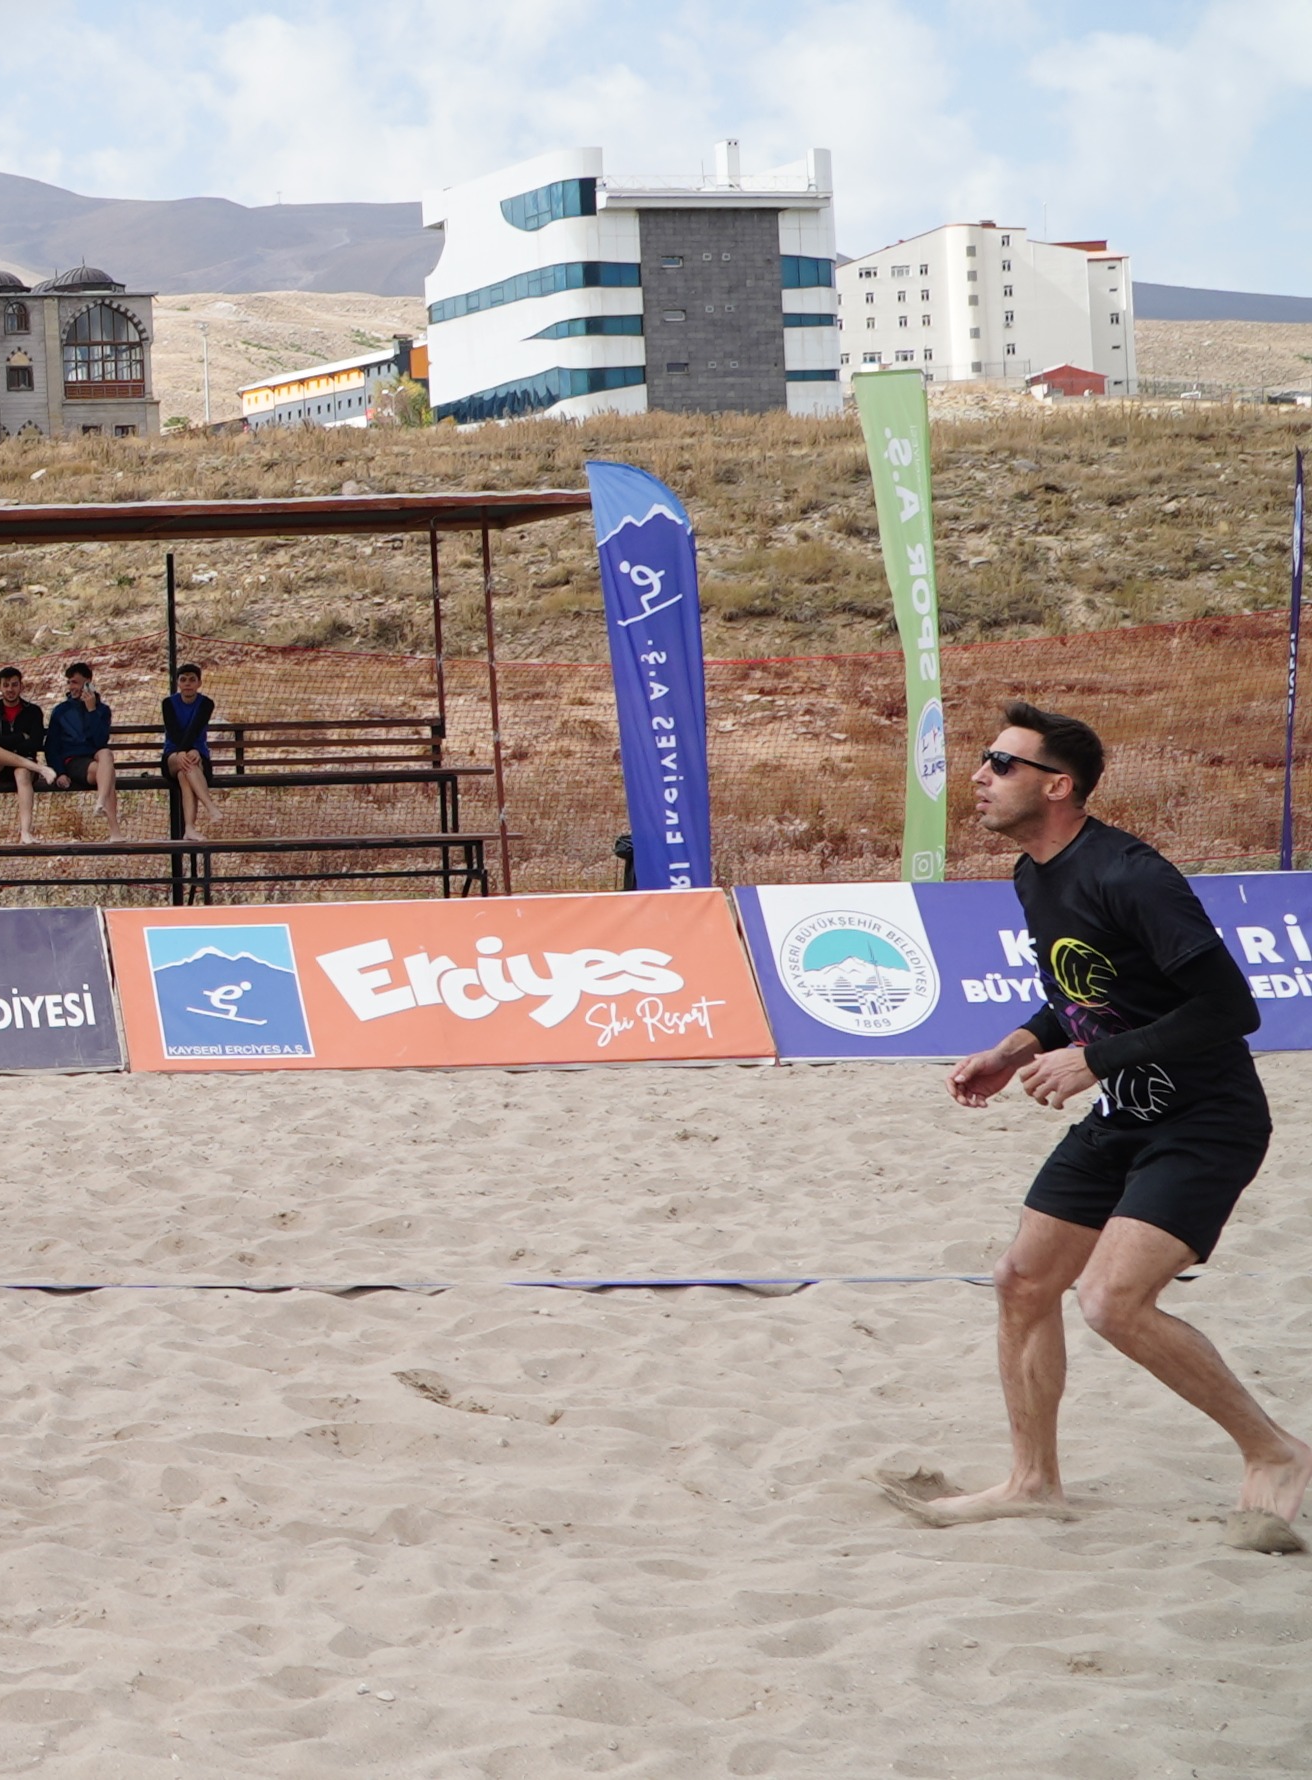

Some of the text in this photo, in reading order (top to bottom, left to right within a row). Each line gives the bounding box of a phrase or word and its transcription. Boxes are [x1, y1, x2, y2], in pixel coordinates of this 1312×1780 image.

[794, 916, 883, 944] BÜYÜKŞEHİR
[315, 935, 685, 1029] Erciyes
[585, 995, 726, 1048] Ski Resort
[854, 1017, 893, 1029] 1869
[168, 1044, 223, 1055] KAYSERİ
[225, 1043, 282, 1055] ERCİYES
